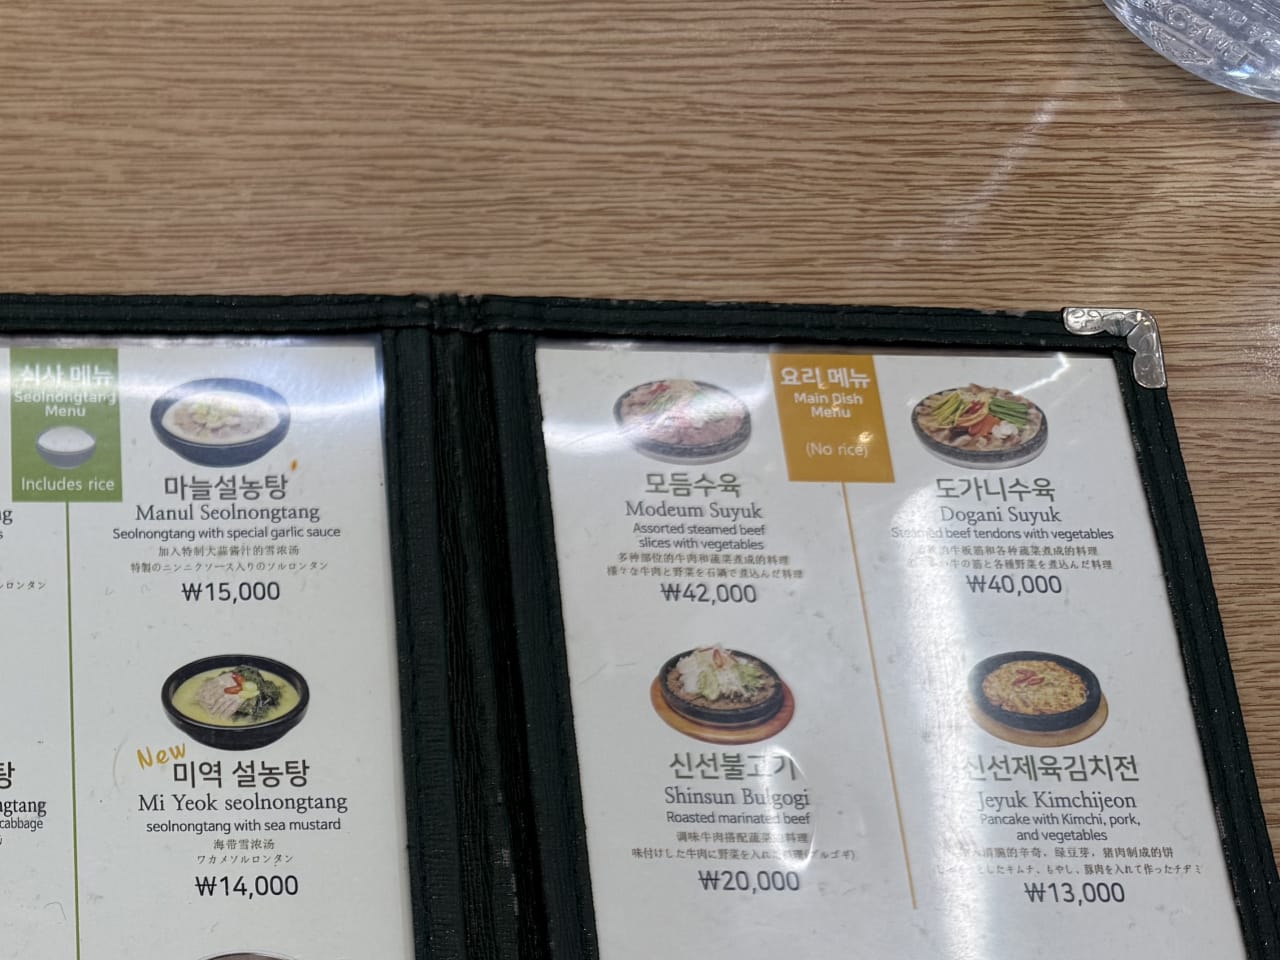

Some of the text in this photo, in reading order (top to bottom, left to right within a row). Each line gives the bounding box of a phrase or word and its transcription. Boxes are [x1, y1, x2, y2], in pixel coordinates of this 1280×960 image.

[780, 366, 872, 389] 요리 메뉴
[164, 473, 289, 501] 마늘설농탕
[645, 472, 742, 499] 모듬수육
[935, 476, 1056, 503] 도가니수육
[135, 502, 321, 524] Manul Seolnongtang
[625, 499, 764, 522] Modeum Suyuk
[940, 505, 1063, 527] Dogani Suyuk
[136, 743, 187, 770] New
[173, 759, 311, 789] 미역 설농탕
[138, 791, 348, 815] Mi Yeok seolnongtang
[664, 785, 737, 805] Shinsun
[146, 817, 341, 836] seolnongtang with sea mustard
